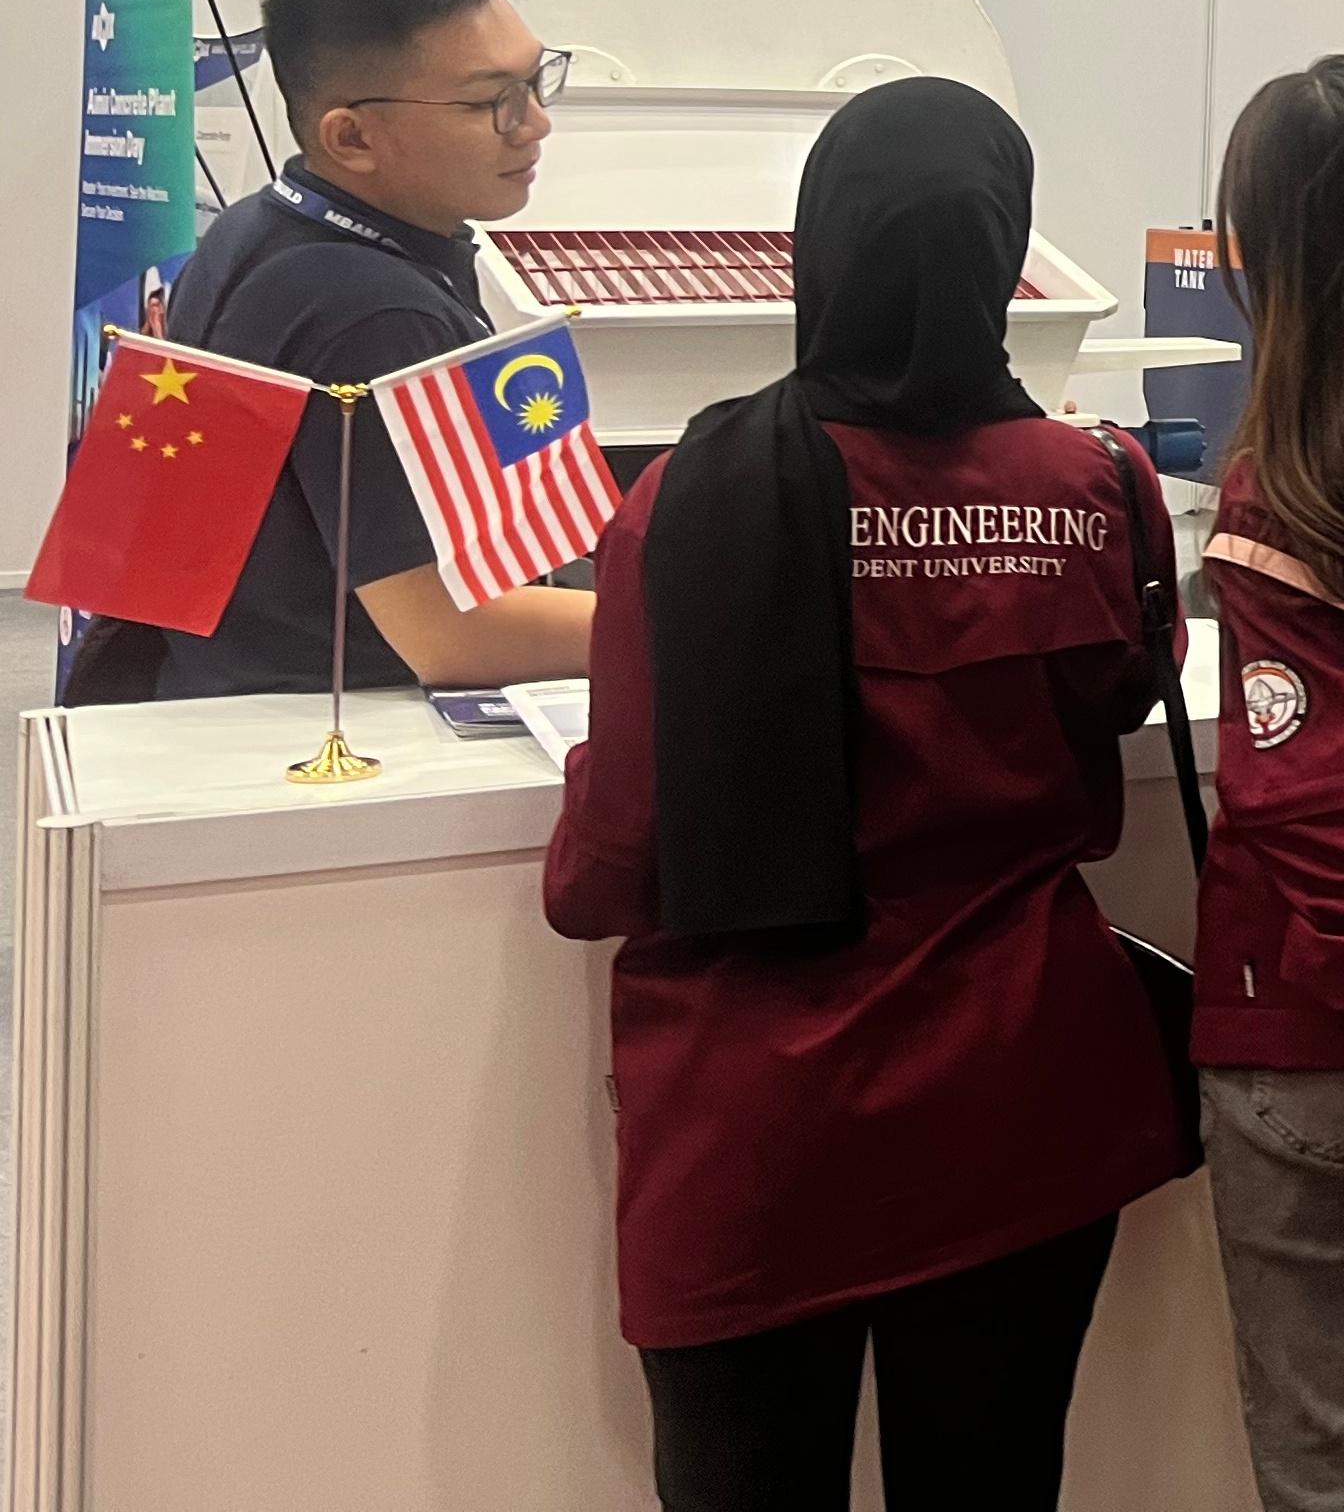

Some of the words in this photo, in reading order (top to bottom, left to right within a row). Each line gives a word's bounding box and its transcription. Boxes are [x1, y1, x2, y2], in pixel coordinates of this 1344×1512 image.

[1174, 248, 1214, 269] WATER
[1174, 269, 1206, 290] TANK
[849, 504, 1109, 551] ENGINEERING
[923, 555, 1068, 579] UNIVERSITY
